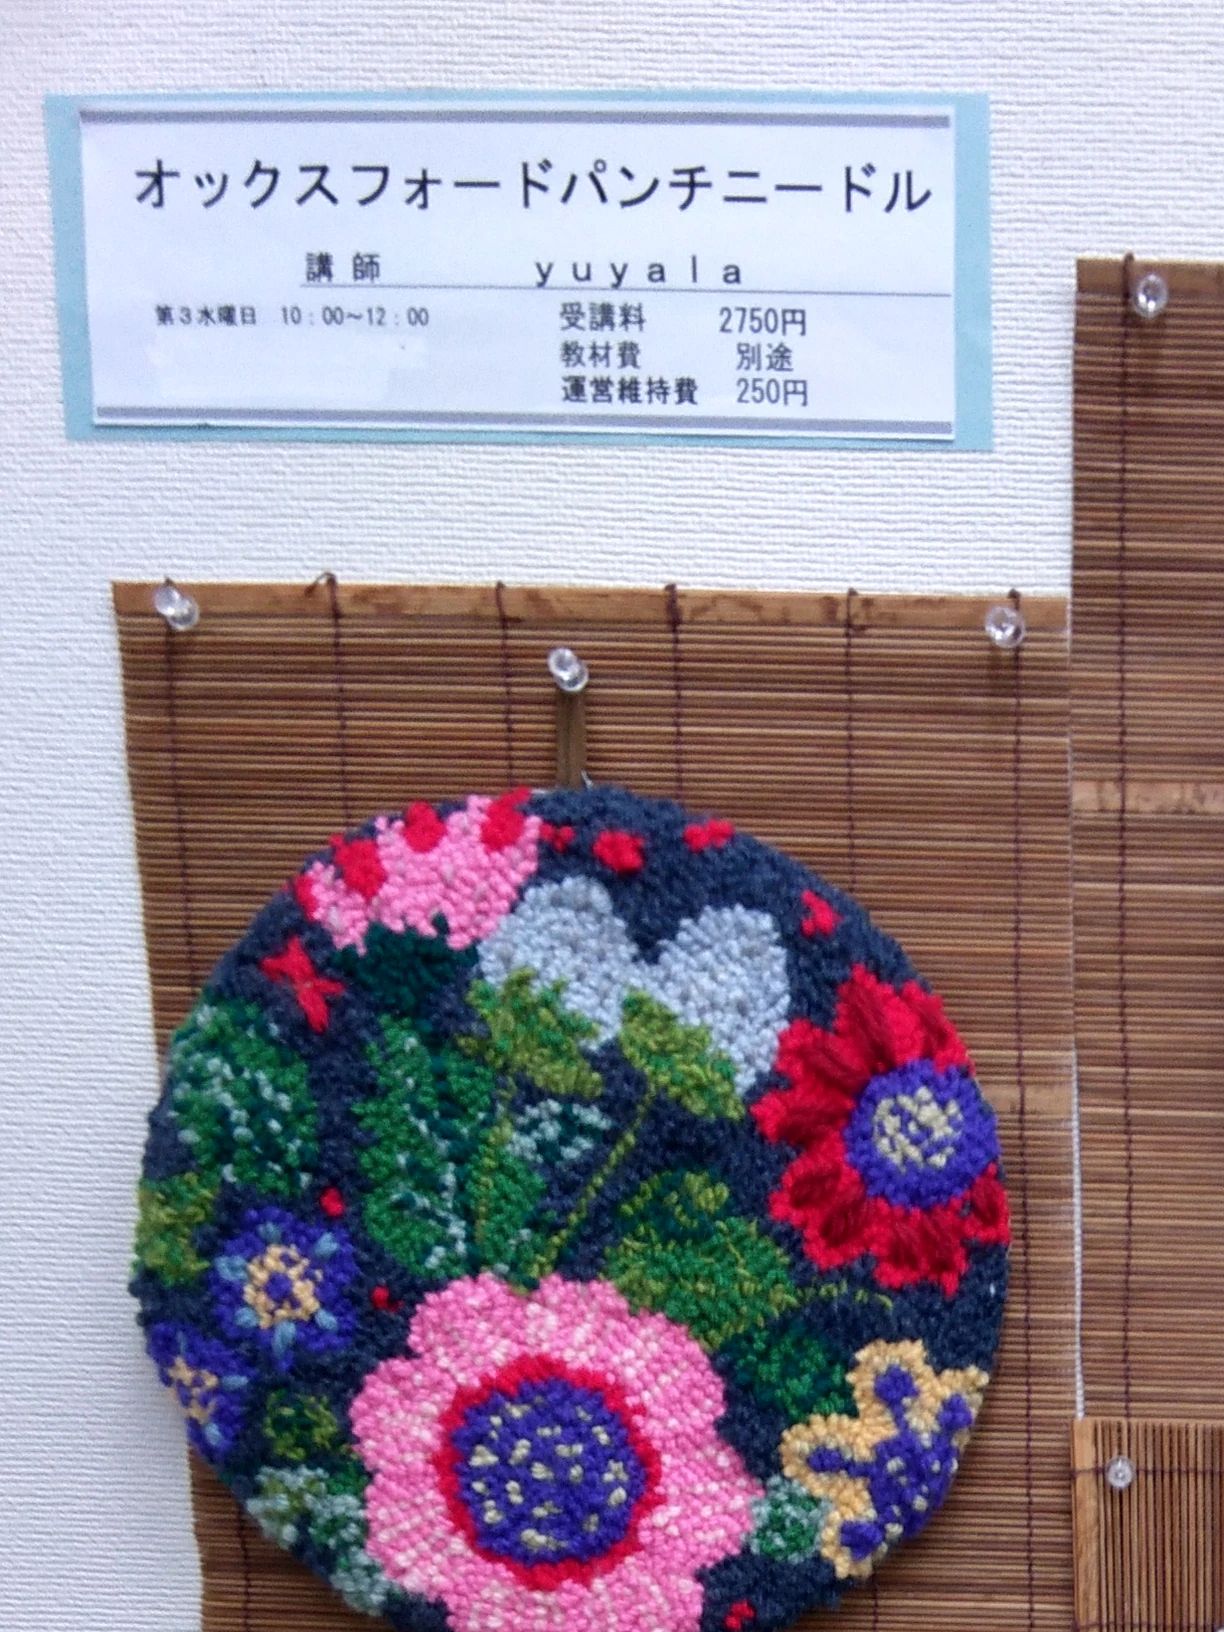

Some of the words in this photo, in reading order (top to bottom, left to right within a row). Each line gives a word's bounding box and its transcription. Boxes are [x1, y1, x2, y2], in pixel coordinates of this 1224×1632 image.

[135, 158, 933, 214] オックスフォードパンチニードル
[305, 250, 382, 284] 講師
[559, 301, 646, 333] 受講料
[718, 306, 808, 337] 2750円
[559, 341, 642, 369] 教材費
[735, 343, 795, 372] 別途
[560, 375, 699, 406] 運営維持費
[735, 378, 809, 407] 250円
